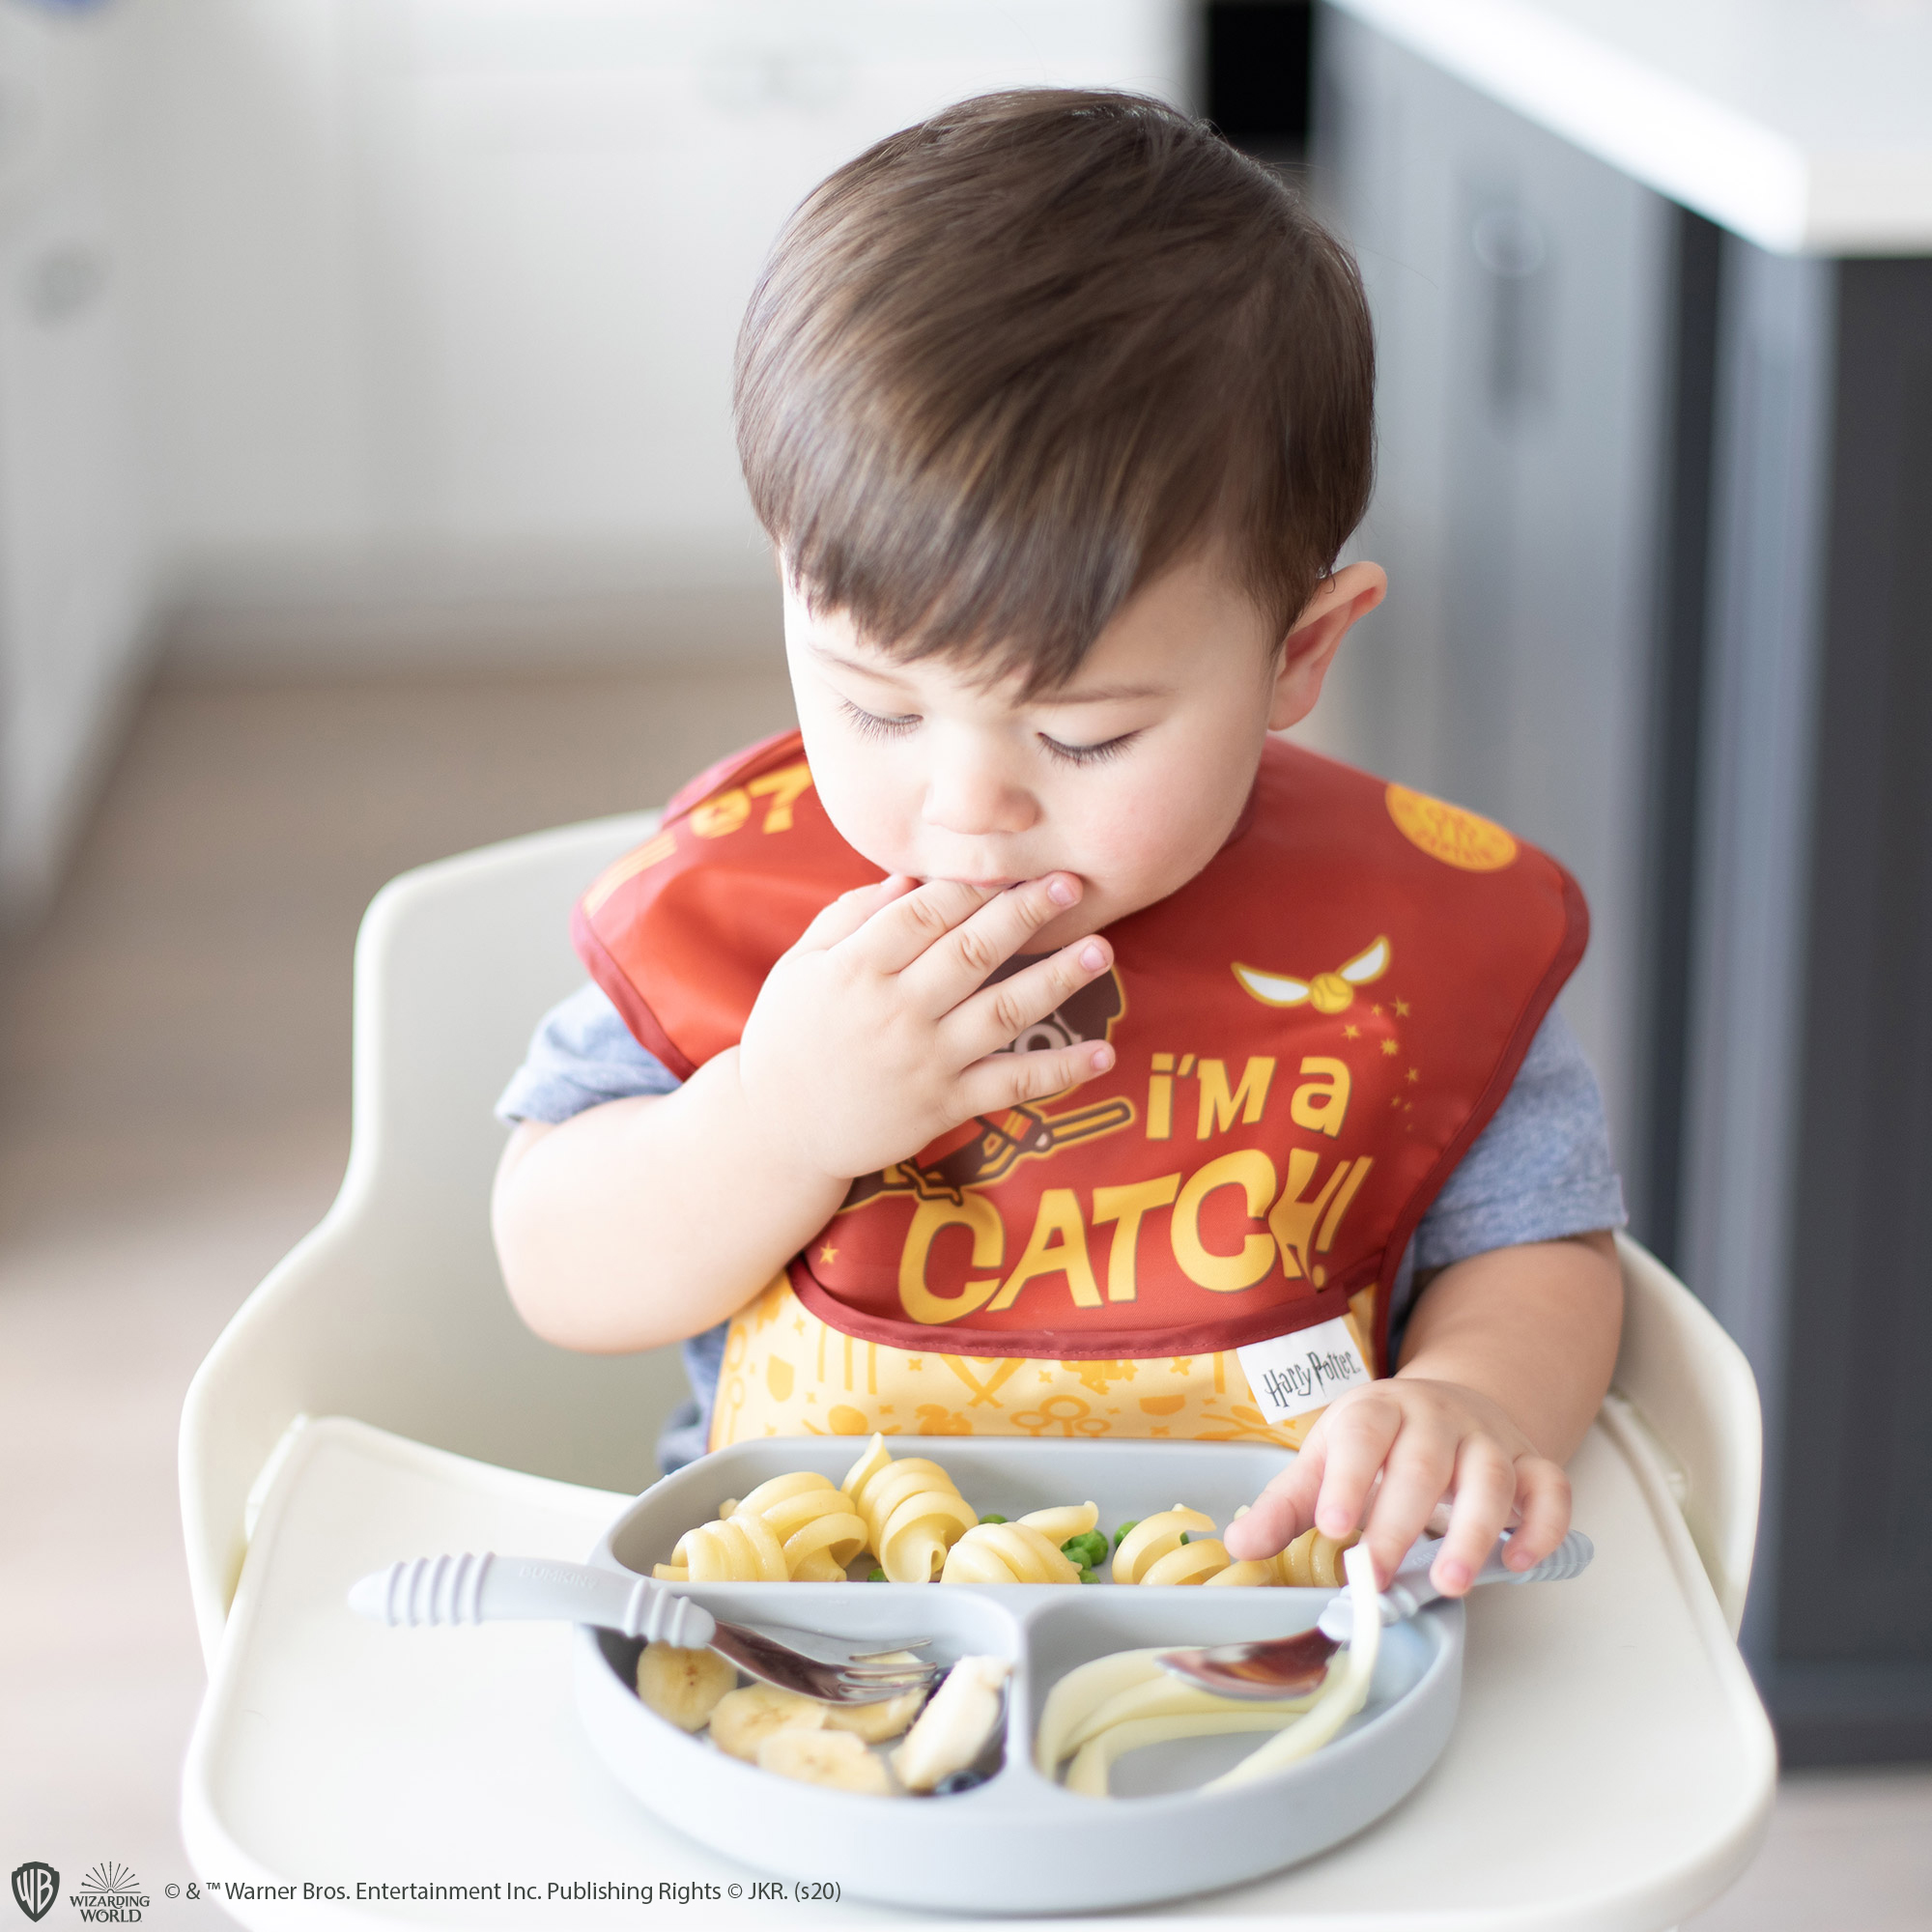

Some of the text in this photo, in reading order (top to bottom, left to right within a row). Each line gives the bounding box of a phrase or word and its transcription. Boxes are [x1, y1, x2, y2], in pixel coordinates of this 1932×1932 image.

[898, 1148, 1374, 1325] CATCH!
[1263, 1351, 1360, 1407] Harry Potter
